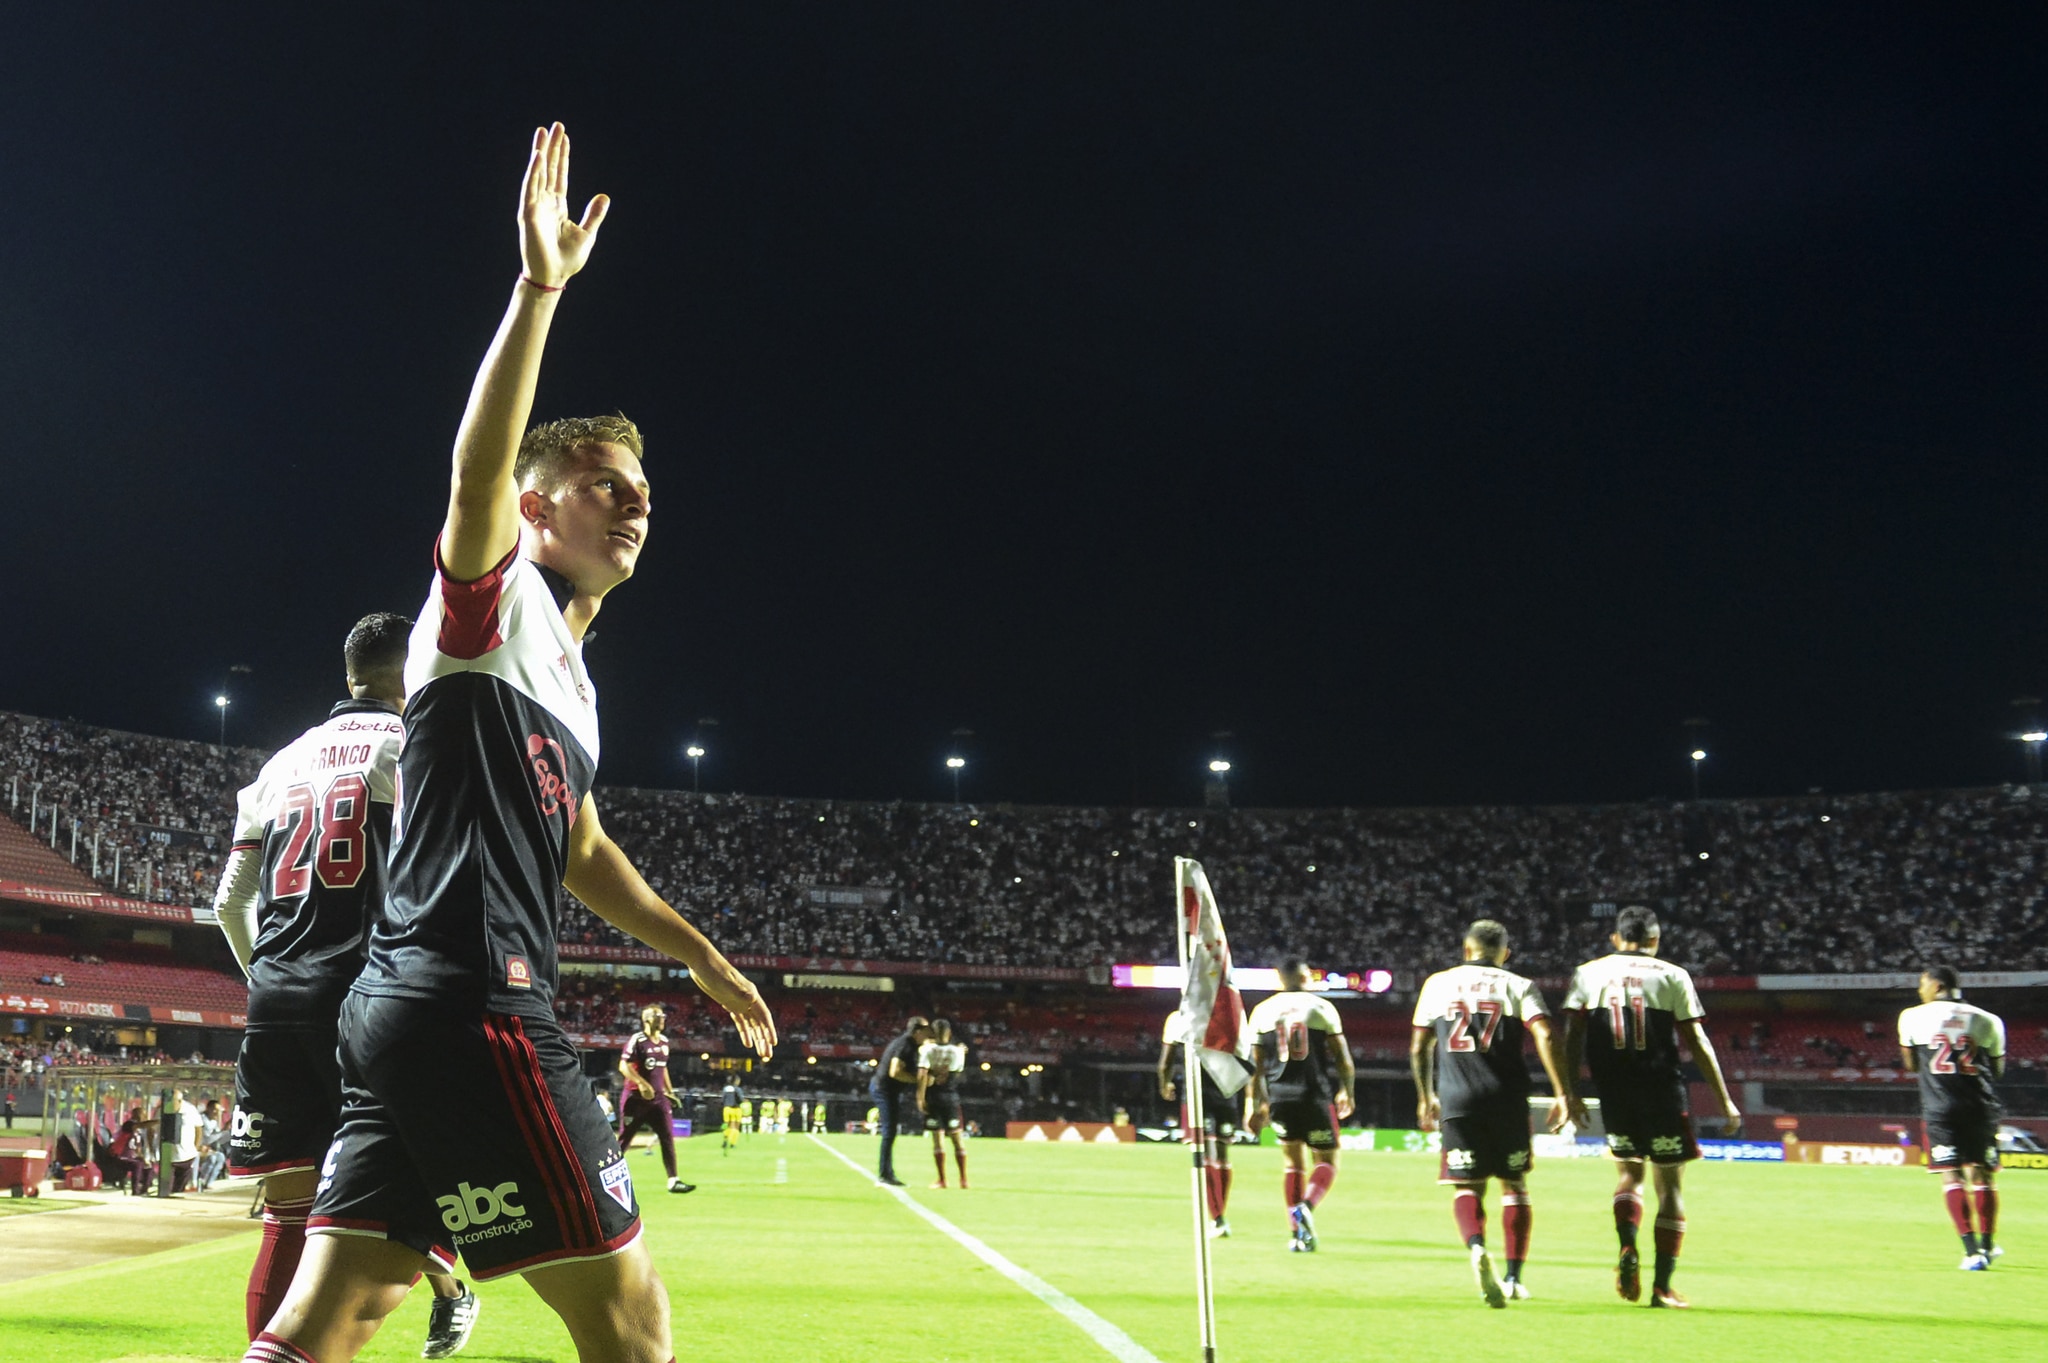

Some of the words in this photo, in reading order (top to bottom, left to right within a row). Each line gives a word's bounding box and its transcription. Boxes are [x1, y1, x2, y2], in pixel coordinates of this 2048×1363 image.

[272, 771, 371, 900] 28
[1448, 1001, 1501, 1052] 27
[1609, 995, 1646, 1050] 11
[1928, 1033, 1979, 1075] 22
[231, 1104, 264, 1138] bc
[1821, 1145, 1906, 1165] BETANO
[436, 1181, 526, 1232] abc
[464, 1218, 533, 1243] construção
